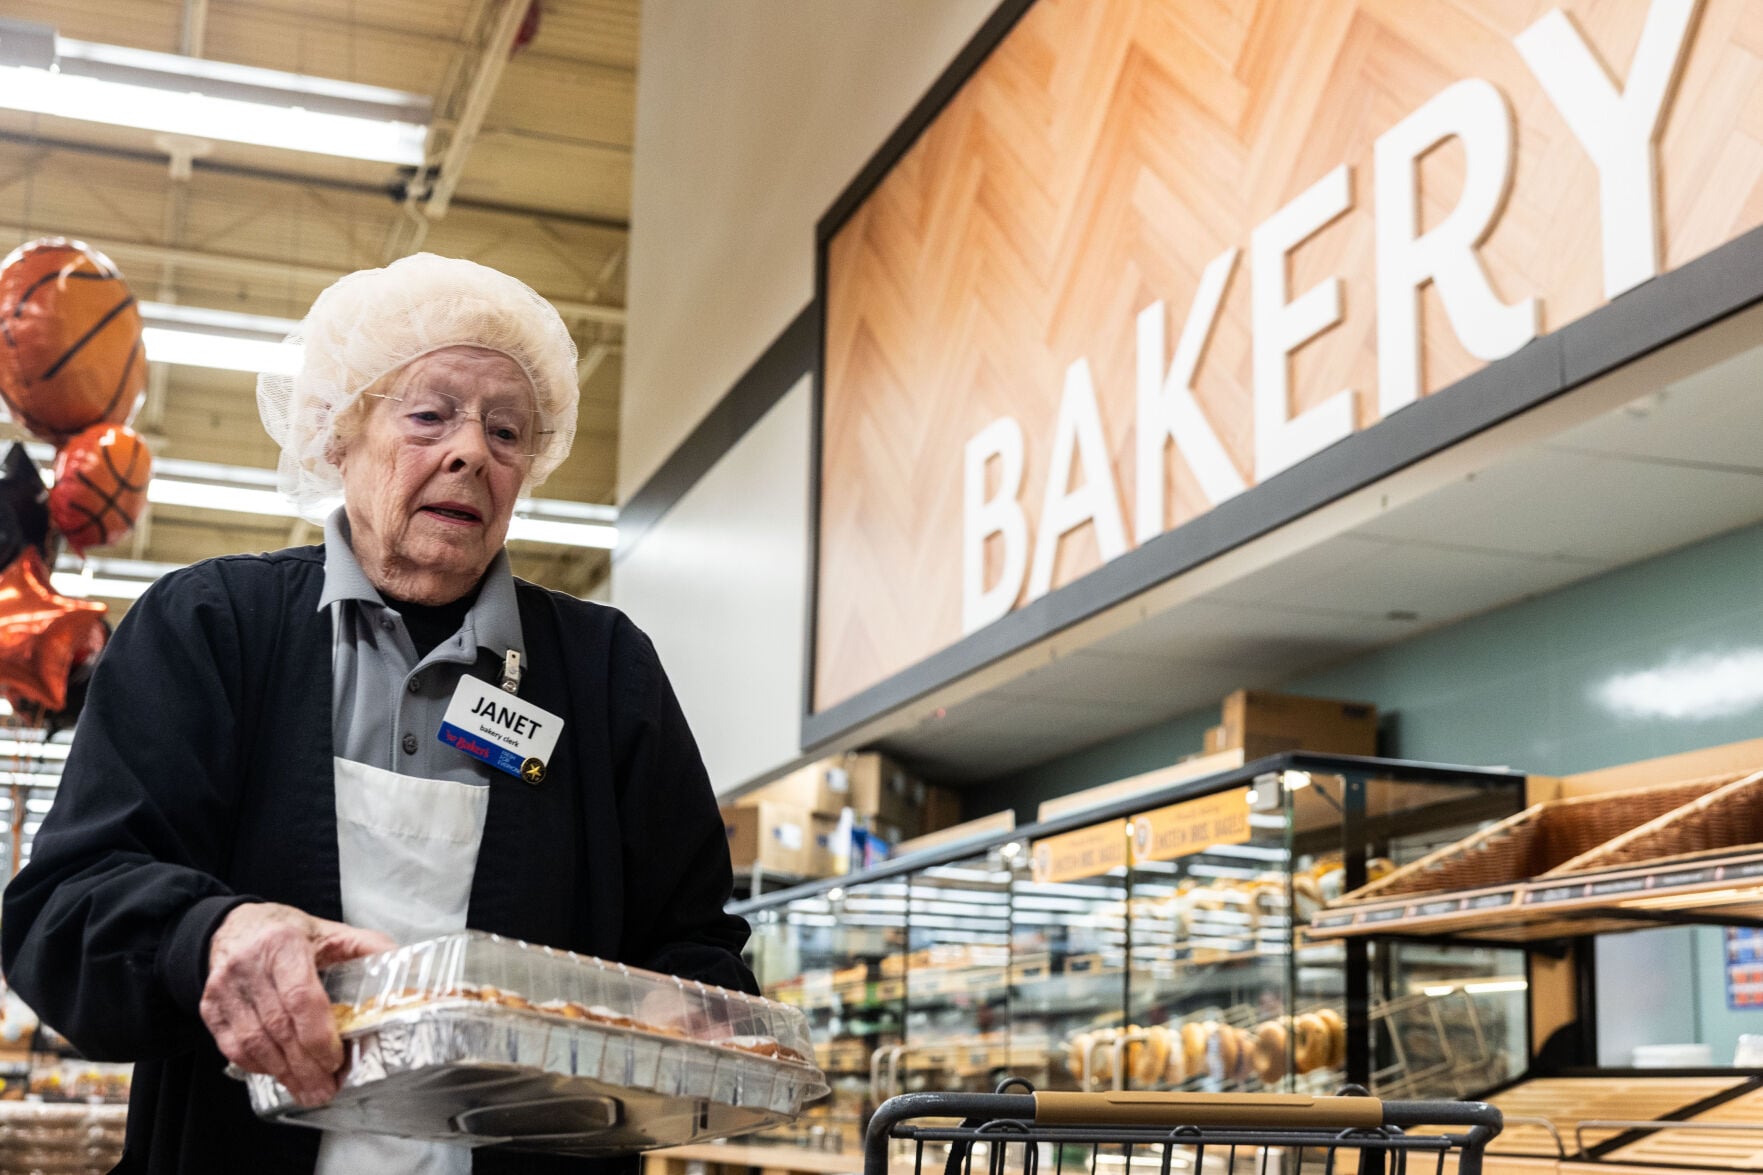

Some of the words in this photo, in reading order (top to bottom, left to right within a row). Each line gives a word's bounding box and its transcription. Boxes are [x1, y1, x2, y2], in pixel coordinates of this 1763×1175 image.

[962, 0, 1700, 636] BAKERY
[471, 697, 542, 740] JANET
[480, 724, 502, 741] bakery
[503, 735, 520, 748] clerk
